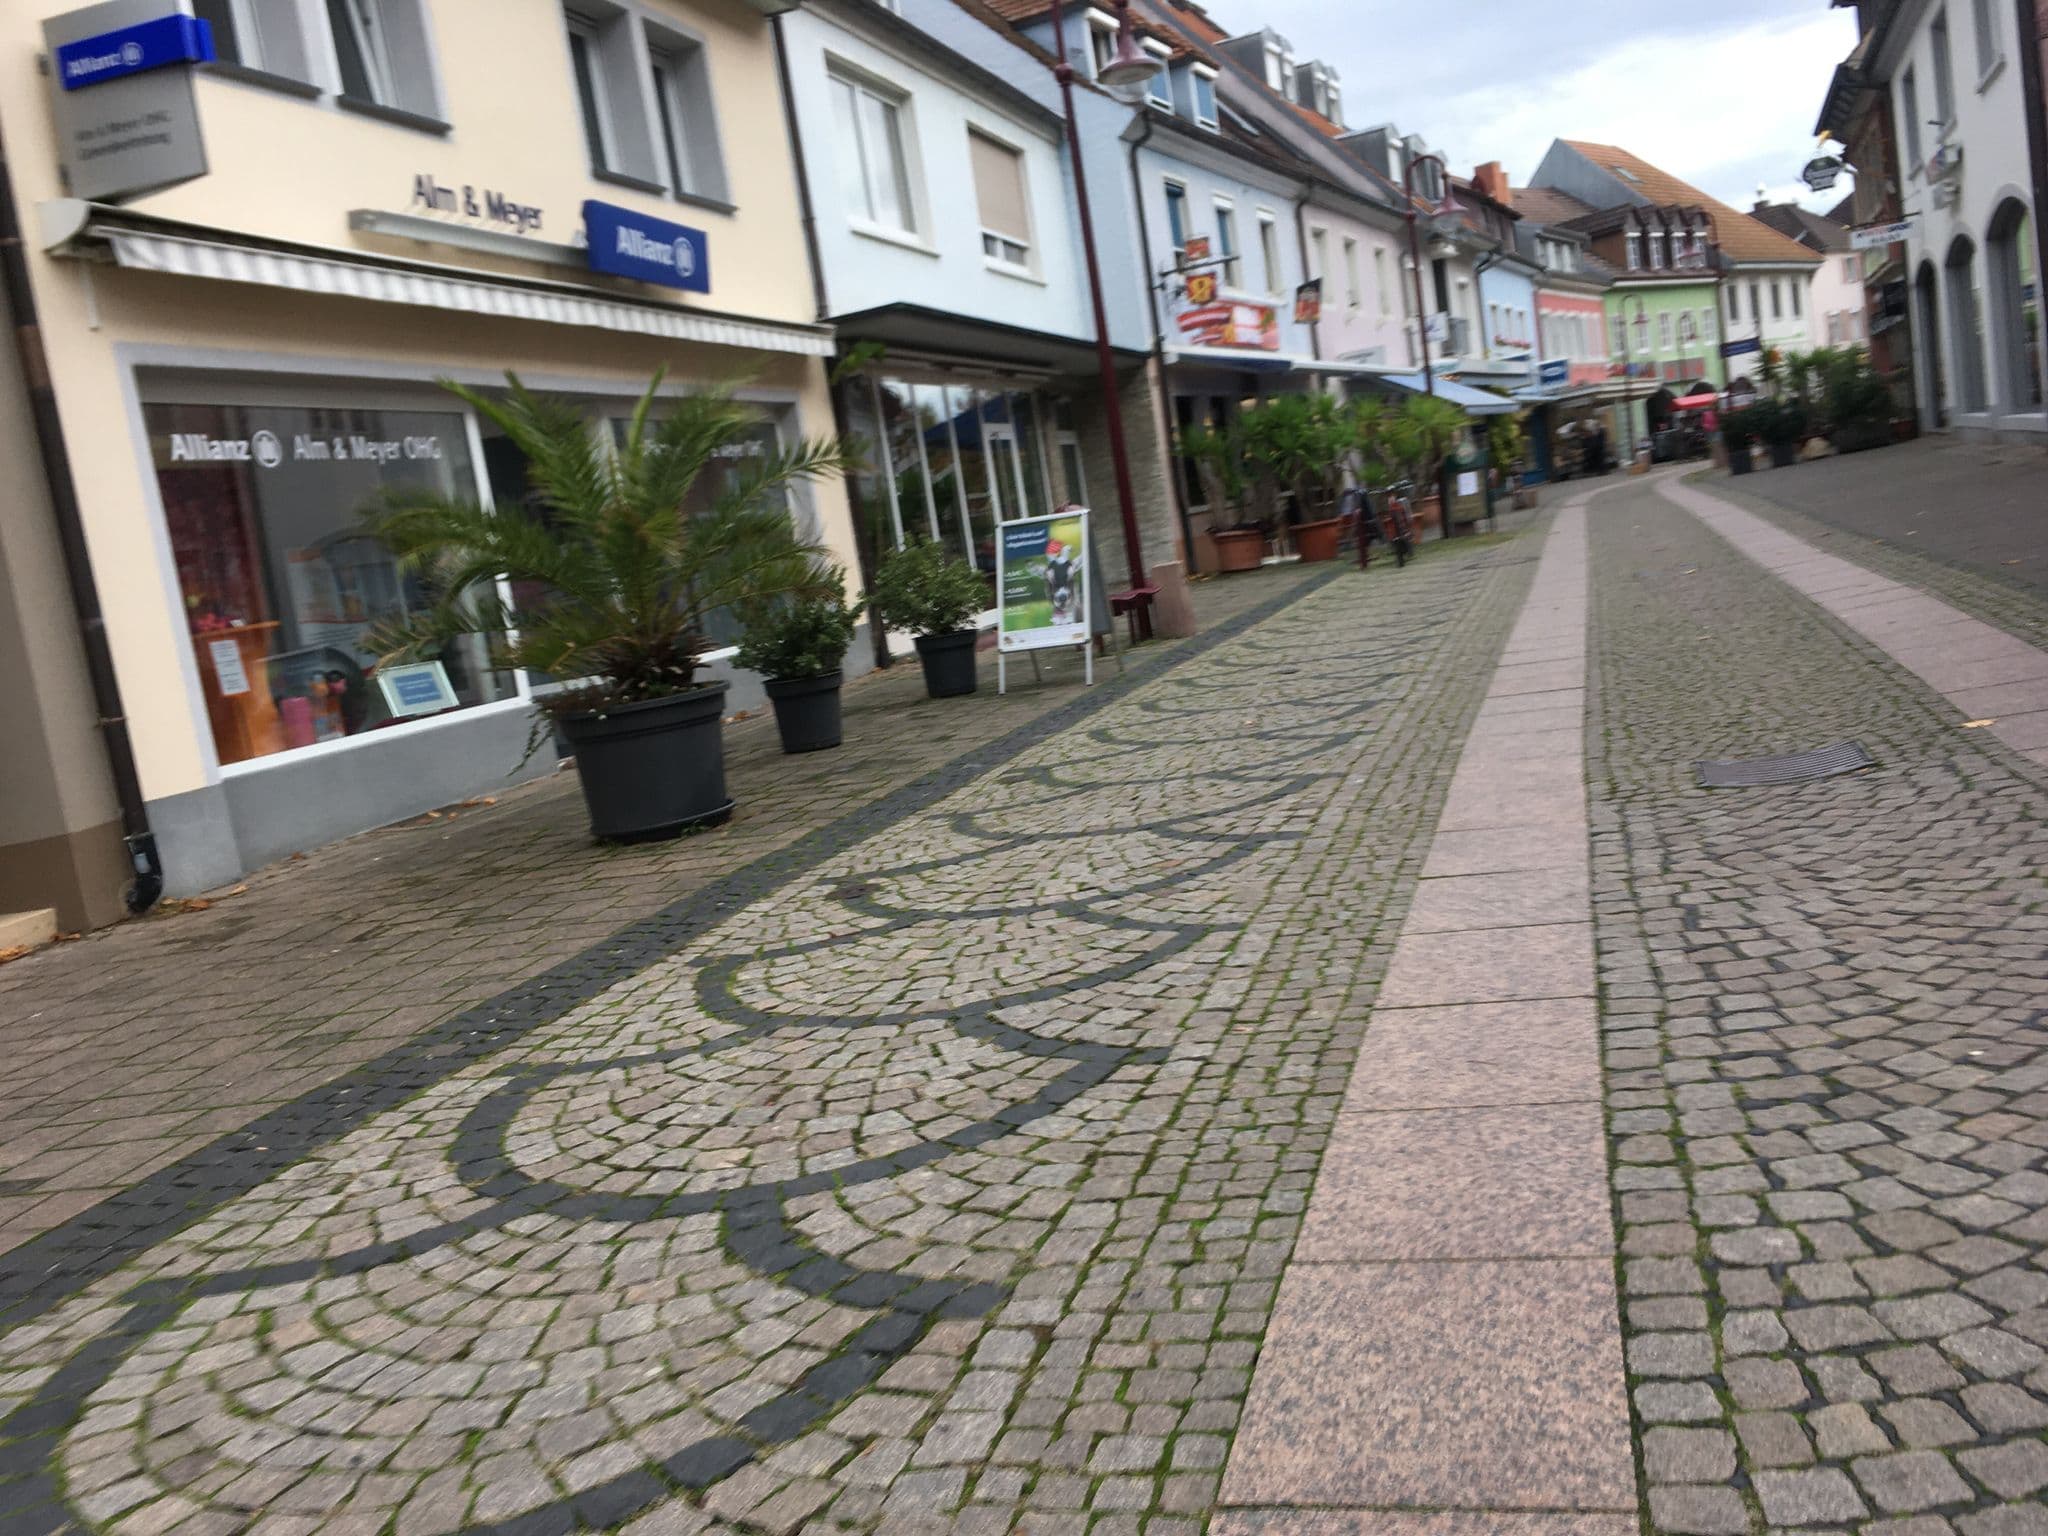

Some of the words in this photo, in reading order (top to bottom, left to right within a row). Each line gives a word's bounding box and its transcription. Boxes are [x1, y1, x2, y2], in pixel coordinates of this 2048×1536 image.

[66, 52, 123, 77] Allianz
[415, 174, 457, 212] Alm
[462, 185, 481, 216] &
[485, 190, 543, 233] Meyer
[616, 226, 675, 265] Allianz
[170, 434, 250, 461] Allianz
[294, 434, 331, 459] Alm
[333, 437, 347, 459] &
[350, 436, 400, 464] Meyer
